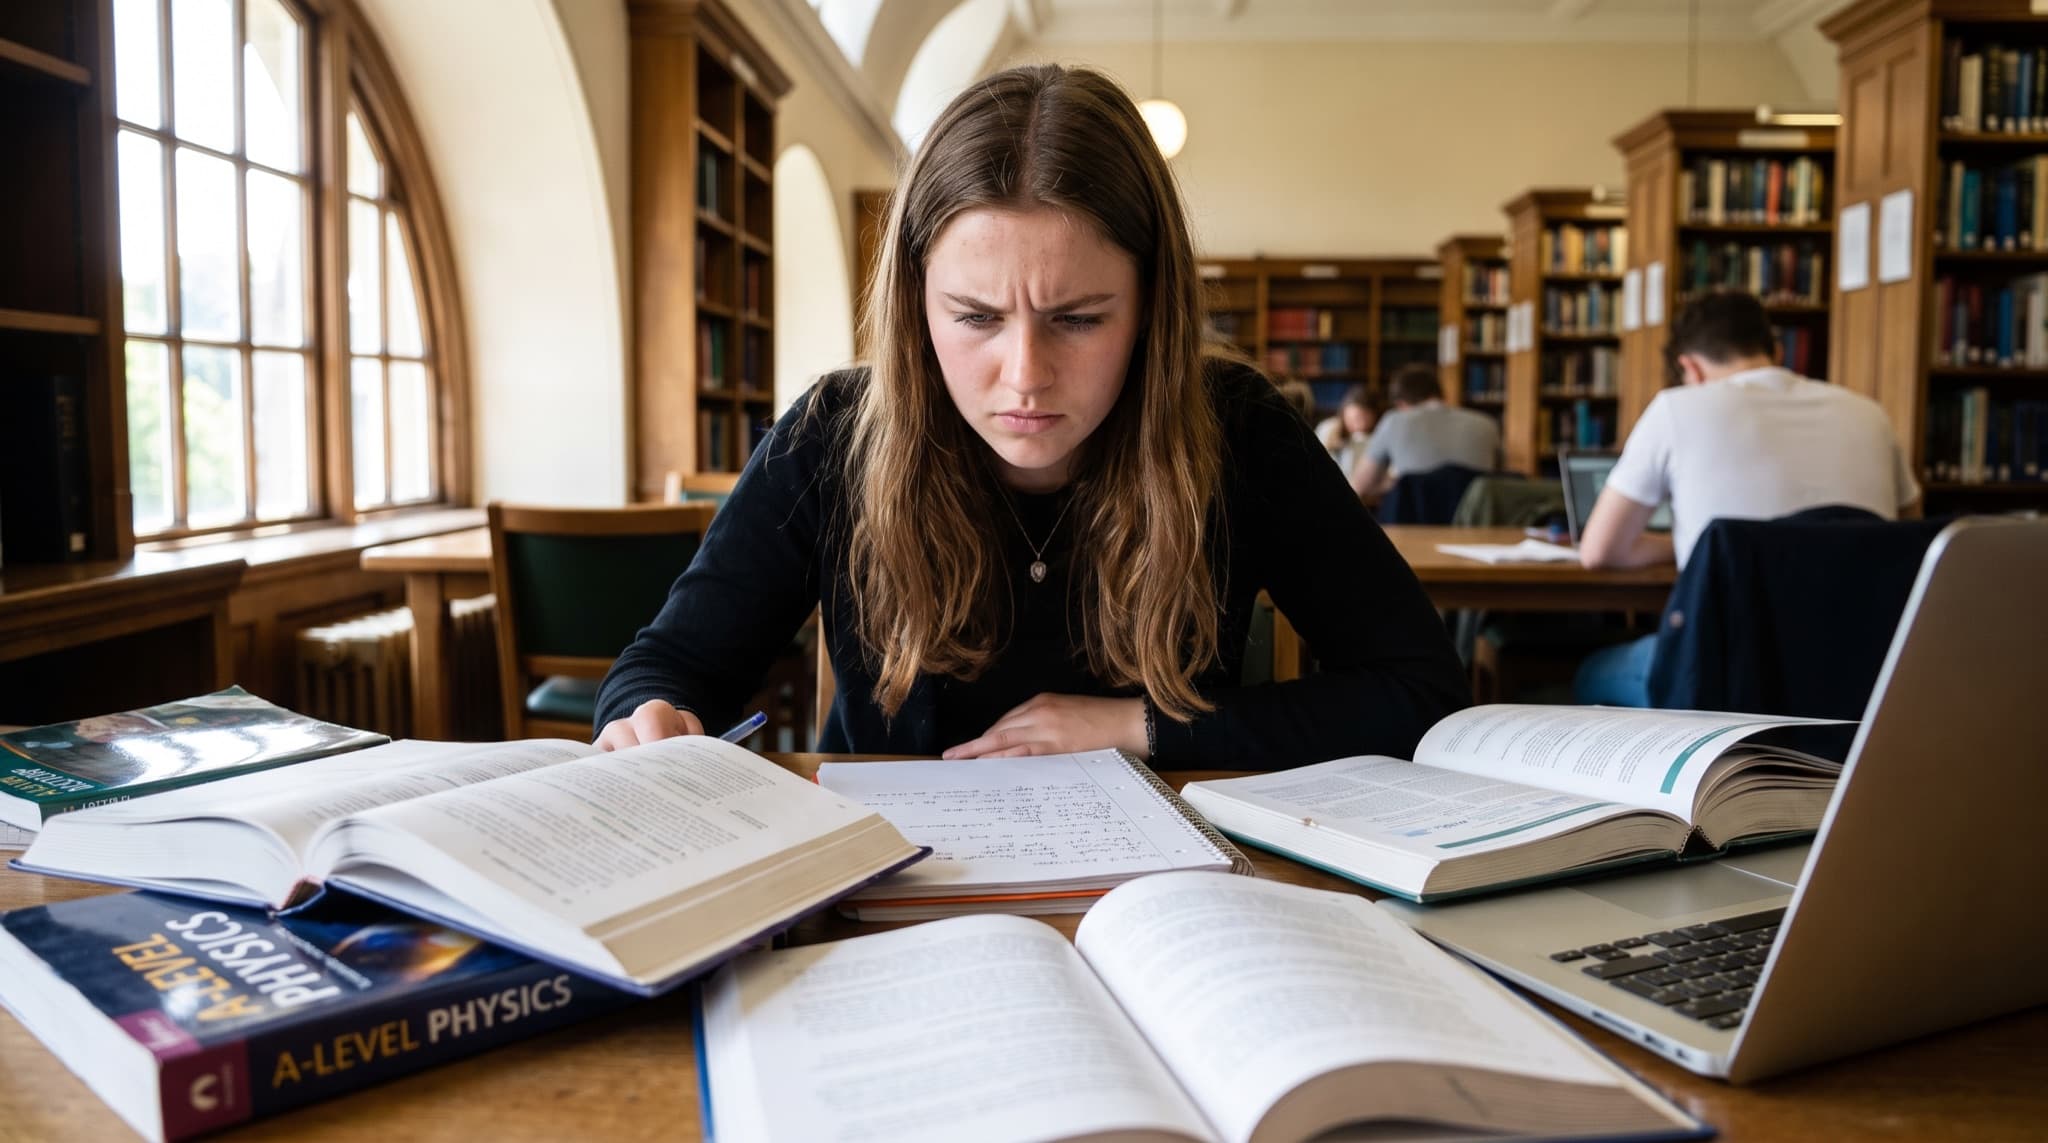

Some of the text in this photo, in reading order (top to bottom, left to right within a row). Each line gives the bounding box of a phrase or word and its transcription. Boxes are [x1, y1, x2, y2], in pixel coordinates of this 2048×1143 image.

[112, 933, 263, 1021] A-LEVEL
[165, 911, 341, 1008] PHYSICS
[272, 1019, 419, 1088] A-LEVEL
[428, 974, 572, 1043] PHYSICS
